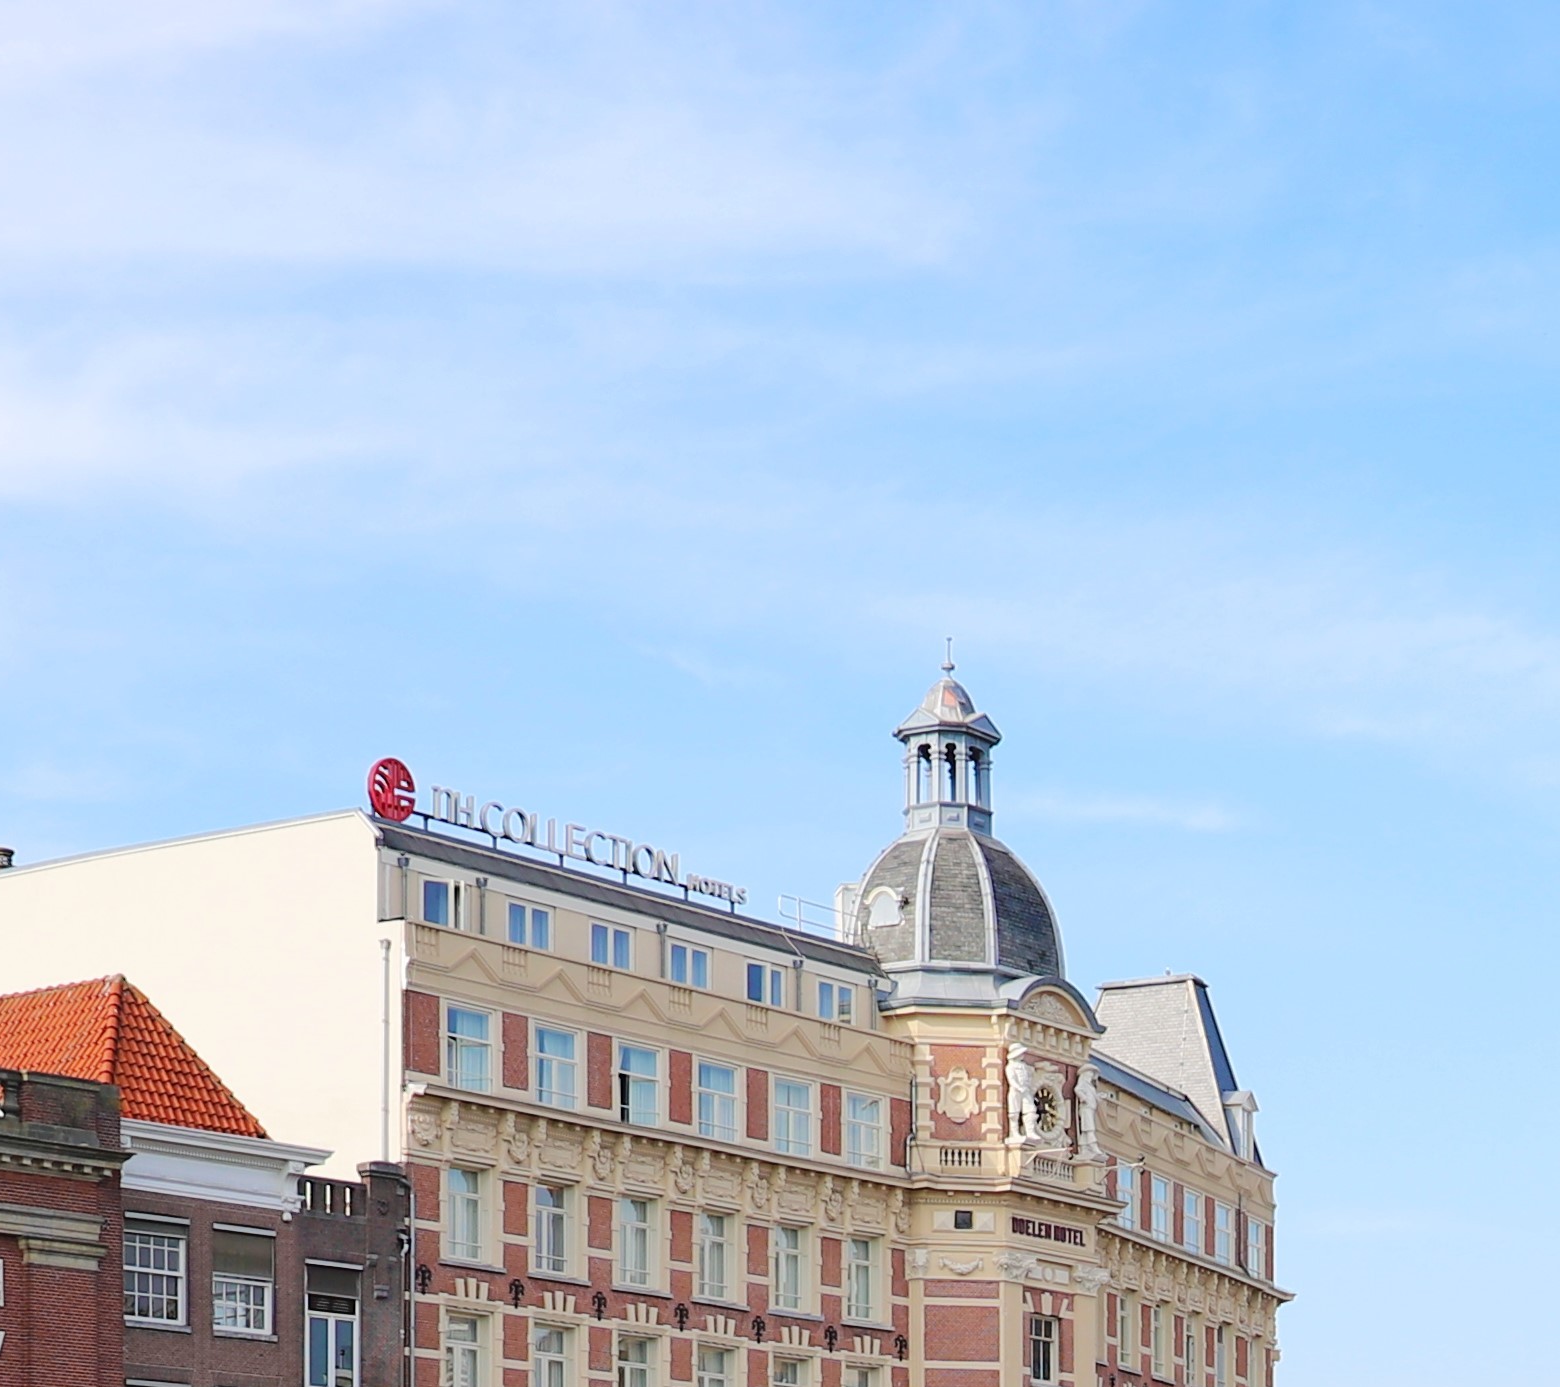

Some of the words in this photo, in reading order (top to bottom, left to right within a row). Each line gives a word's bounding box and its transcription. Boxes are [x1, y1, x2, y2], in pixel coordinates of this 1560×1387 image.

[479, 800, 682, 887] COLLECTION
[686, 872, 747, 906] HOTELS
[1011, 1216, 1052, 1240] DOELEN
[1053, 1224, 1086, 1248] HOTEL
